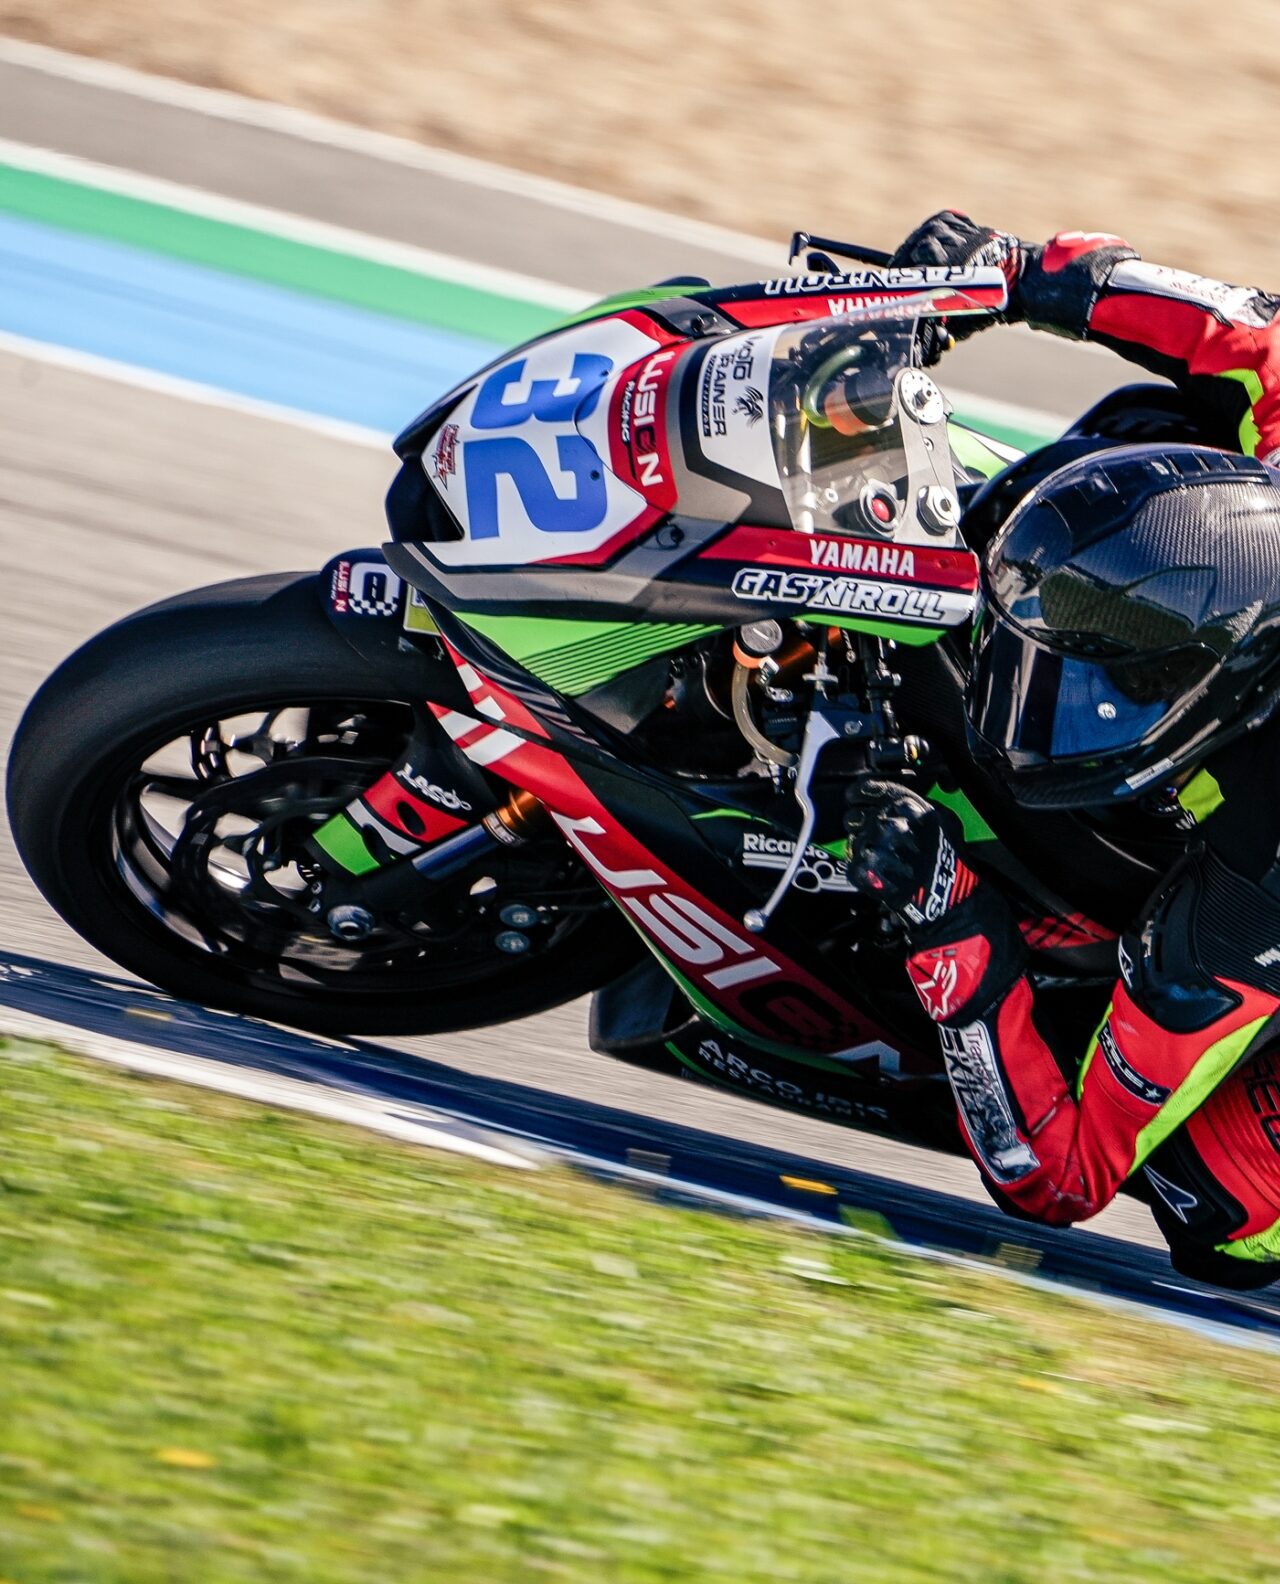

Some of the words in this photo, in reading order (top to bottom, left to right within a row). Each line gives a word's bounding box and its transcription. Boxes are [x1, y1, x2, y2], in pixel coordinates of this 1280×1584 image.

[463, 353, 613, 540] 32
[809, 539, 915, 577] YAMAHA
[700, 1038, 803, 1095] ARCO
